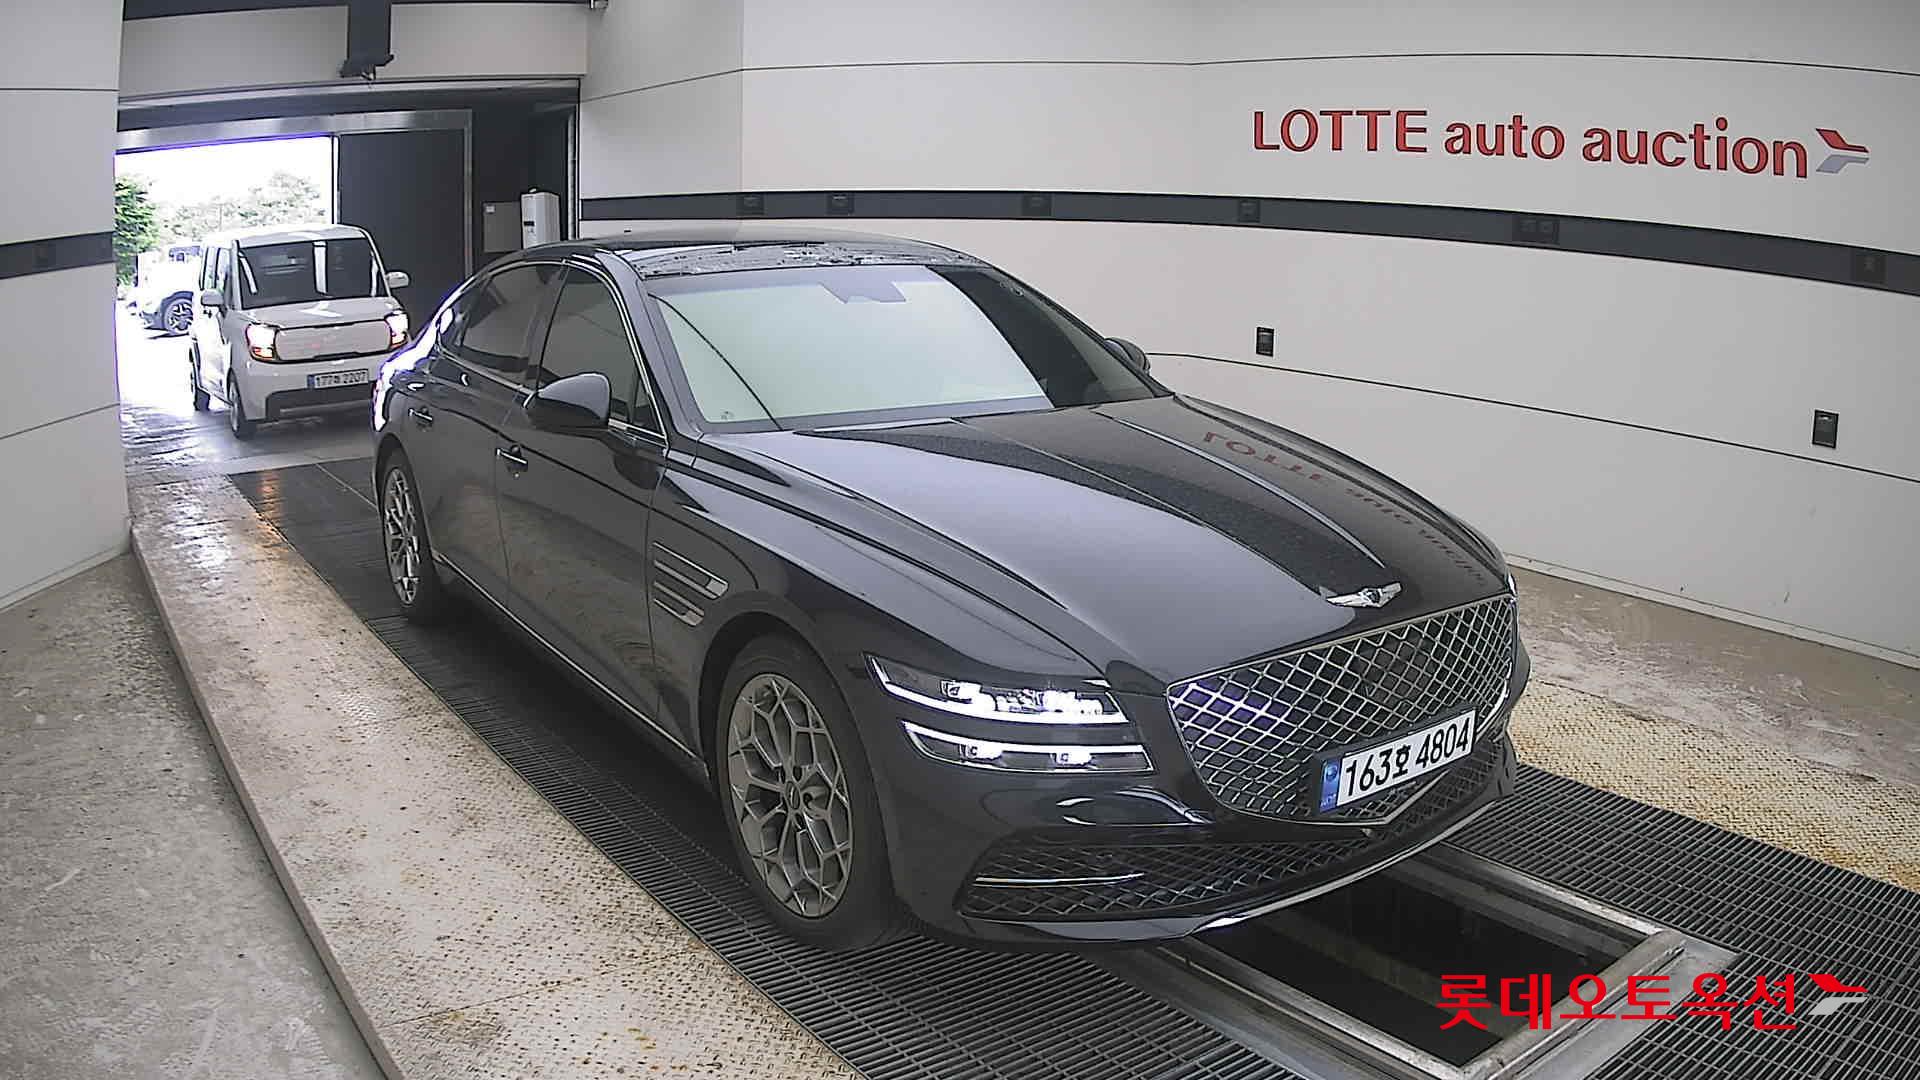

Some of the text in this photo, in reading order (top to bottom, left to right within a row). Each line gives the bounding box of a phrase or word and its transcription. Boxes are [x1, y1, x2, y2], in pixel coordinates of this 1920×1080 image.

[1254, 109, 1809, 178] LOTTE auto auction
[1346, 717, 1470, 796] 163호 4804
